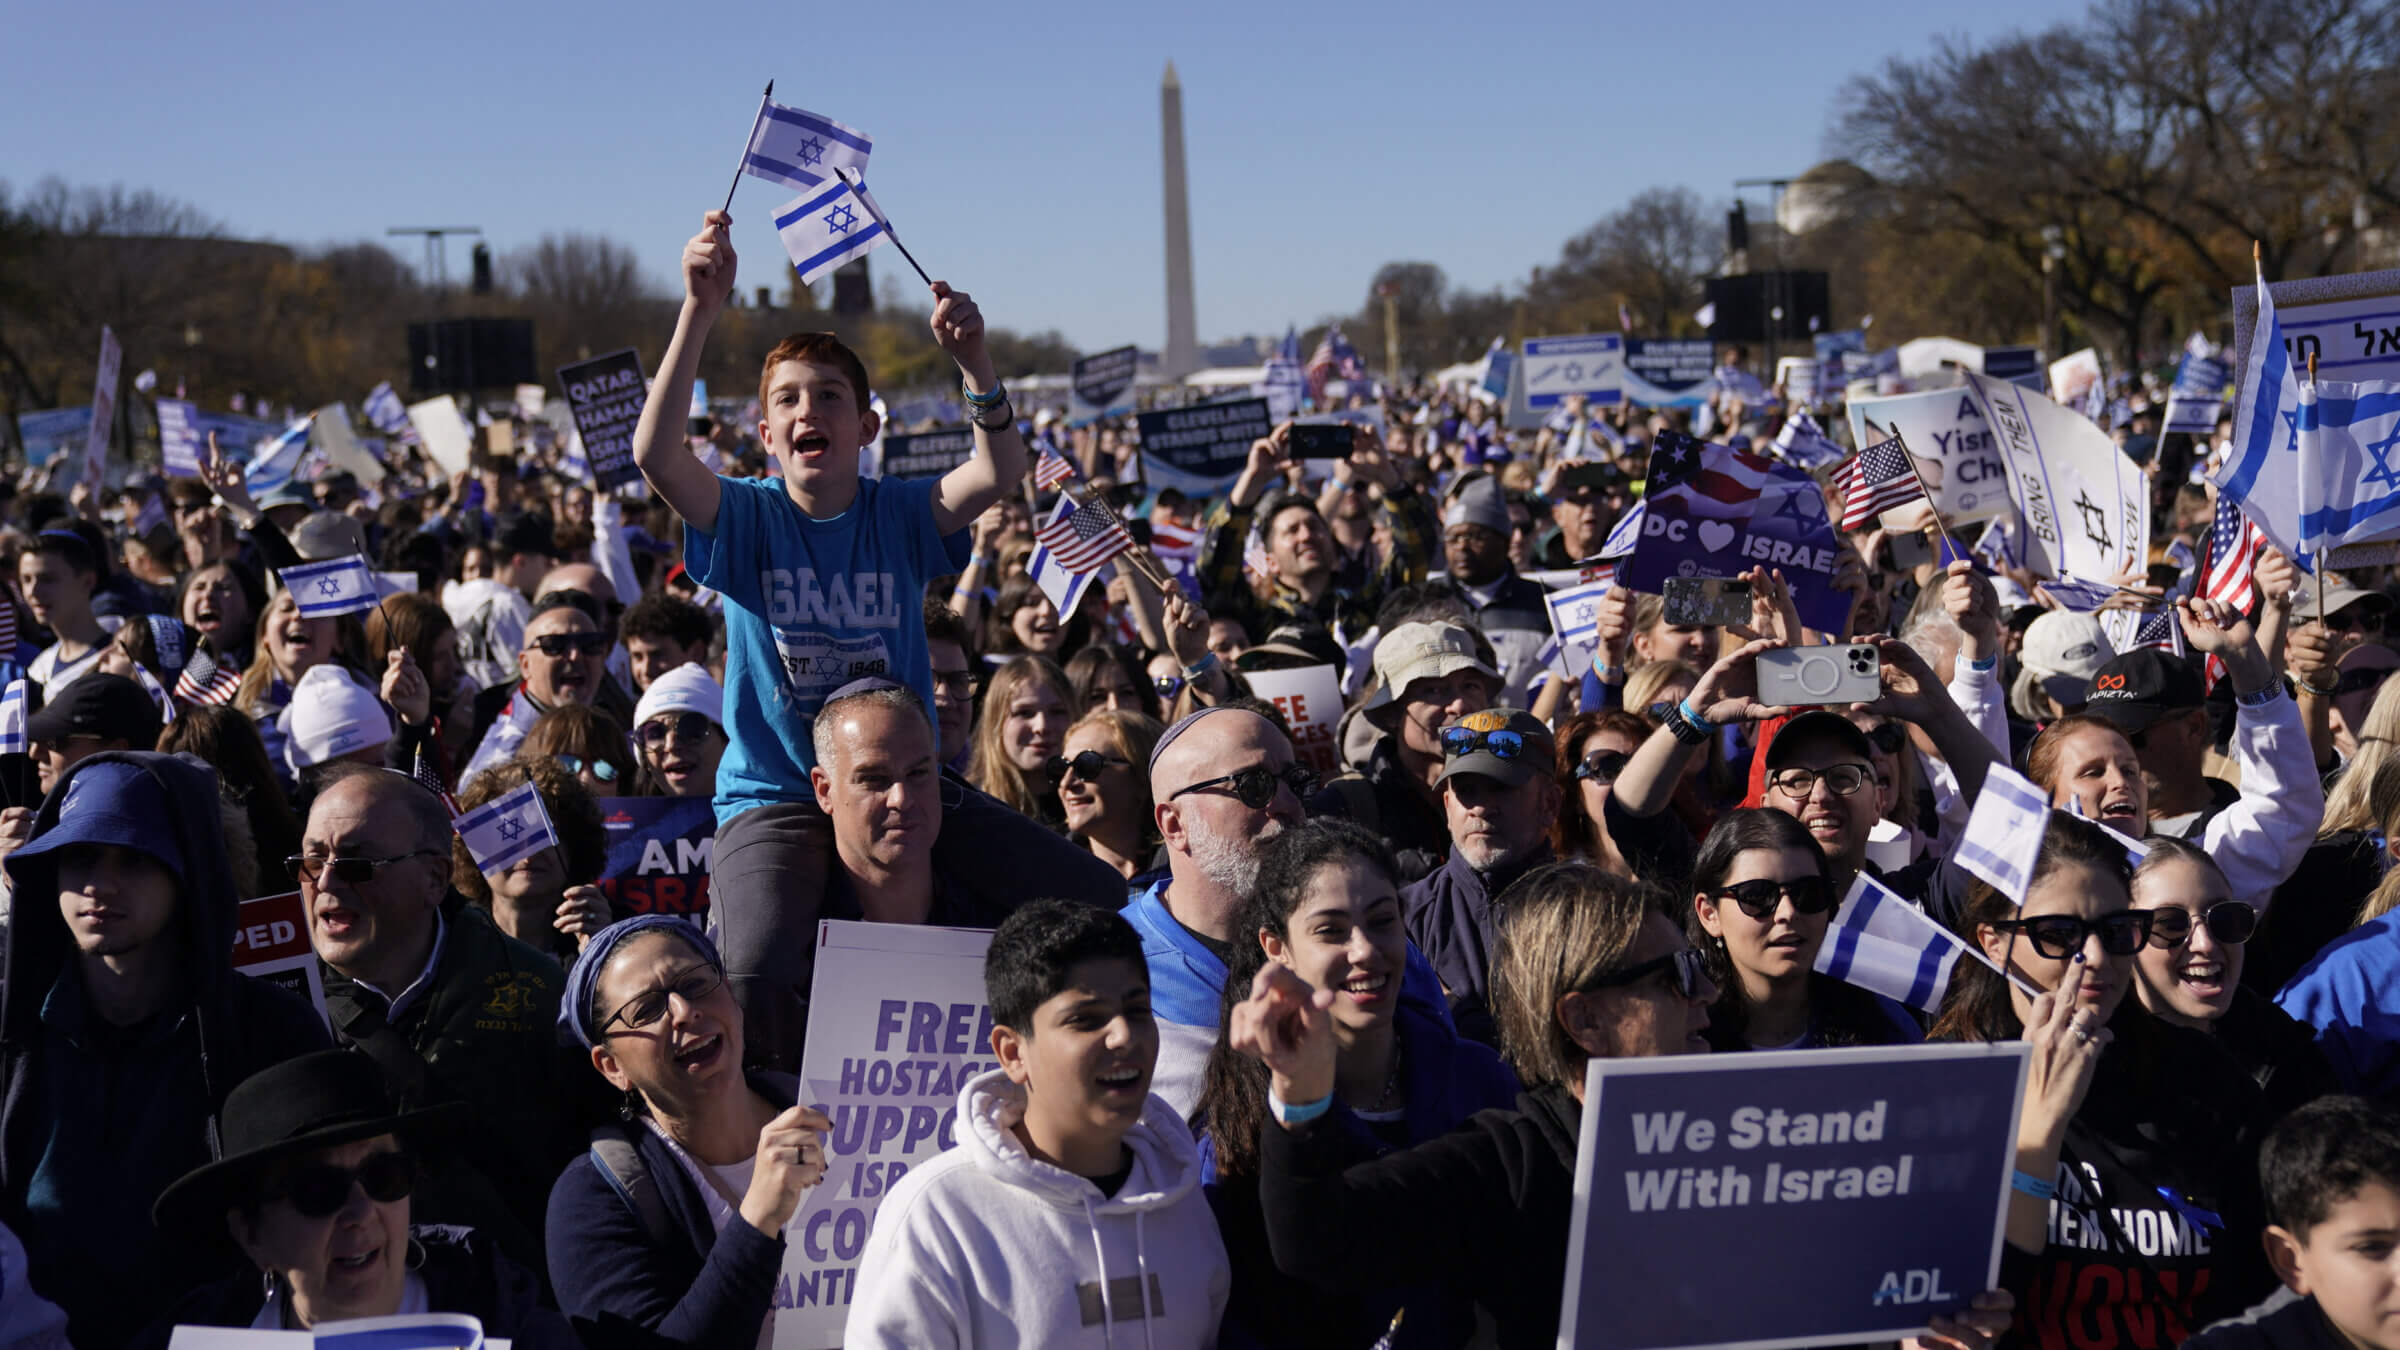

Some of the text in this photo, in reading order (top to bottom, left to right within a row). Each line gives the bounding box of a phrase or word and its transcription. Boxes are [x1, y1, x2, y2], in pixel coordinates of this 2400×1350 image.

[569, 368, 640, 403] QATAR:
[1957, 395, 1985, 420] A
[1146, 420, 1269, 451] STANDS WITH
[1994, 398, 2055, 544] BRING THEM
[1643, 514, 1689, 543] DC
[761, 567, 901, 629] ISRAEL
[849, 658, 886, 677] 1948
[636, 837, 714, 876] AM
[1631, 1110, 1716, 1155] We
[1727, 1100, 1888, 1151] Stand
[1625, 1167, 1752, 1213] With
[1762, 1154, 1914, 1204] Israel
[804, 1207, 876, 1262] CO
[1872, 1267, 1953, 1307] ADL
